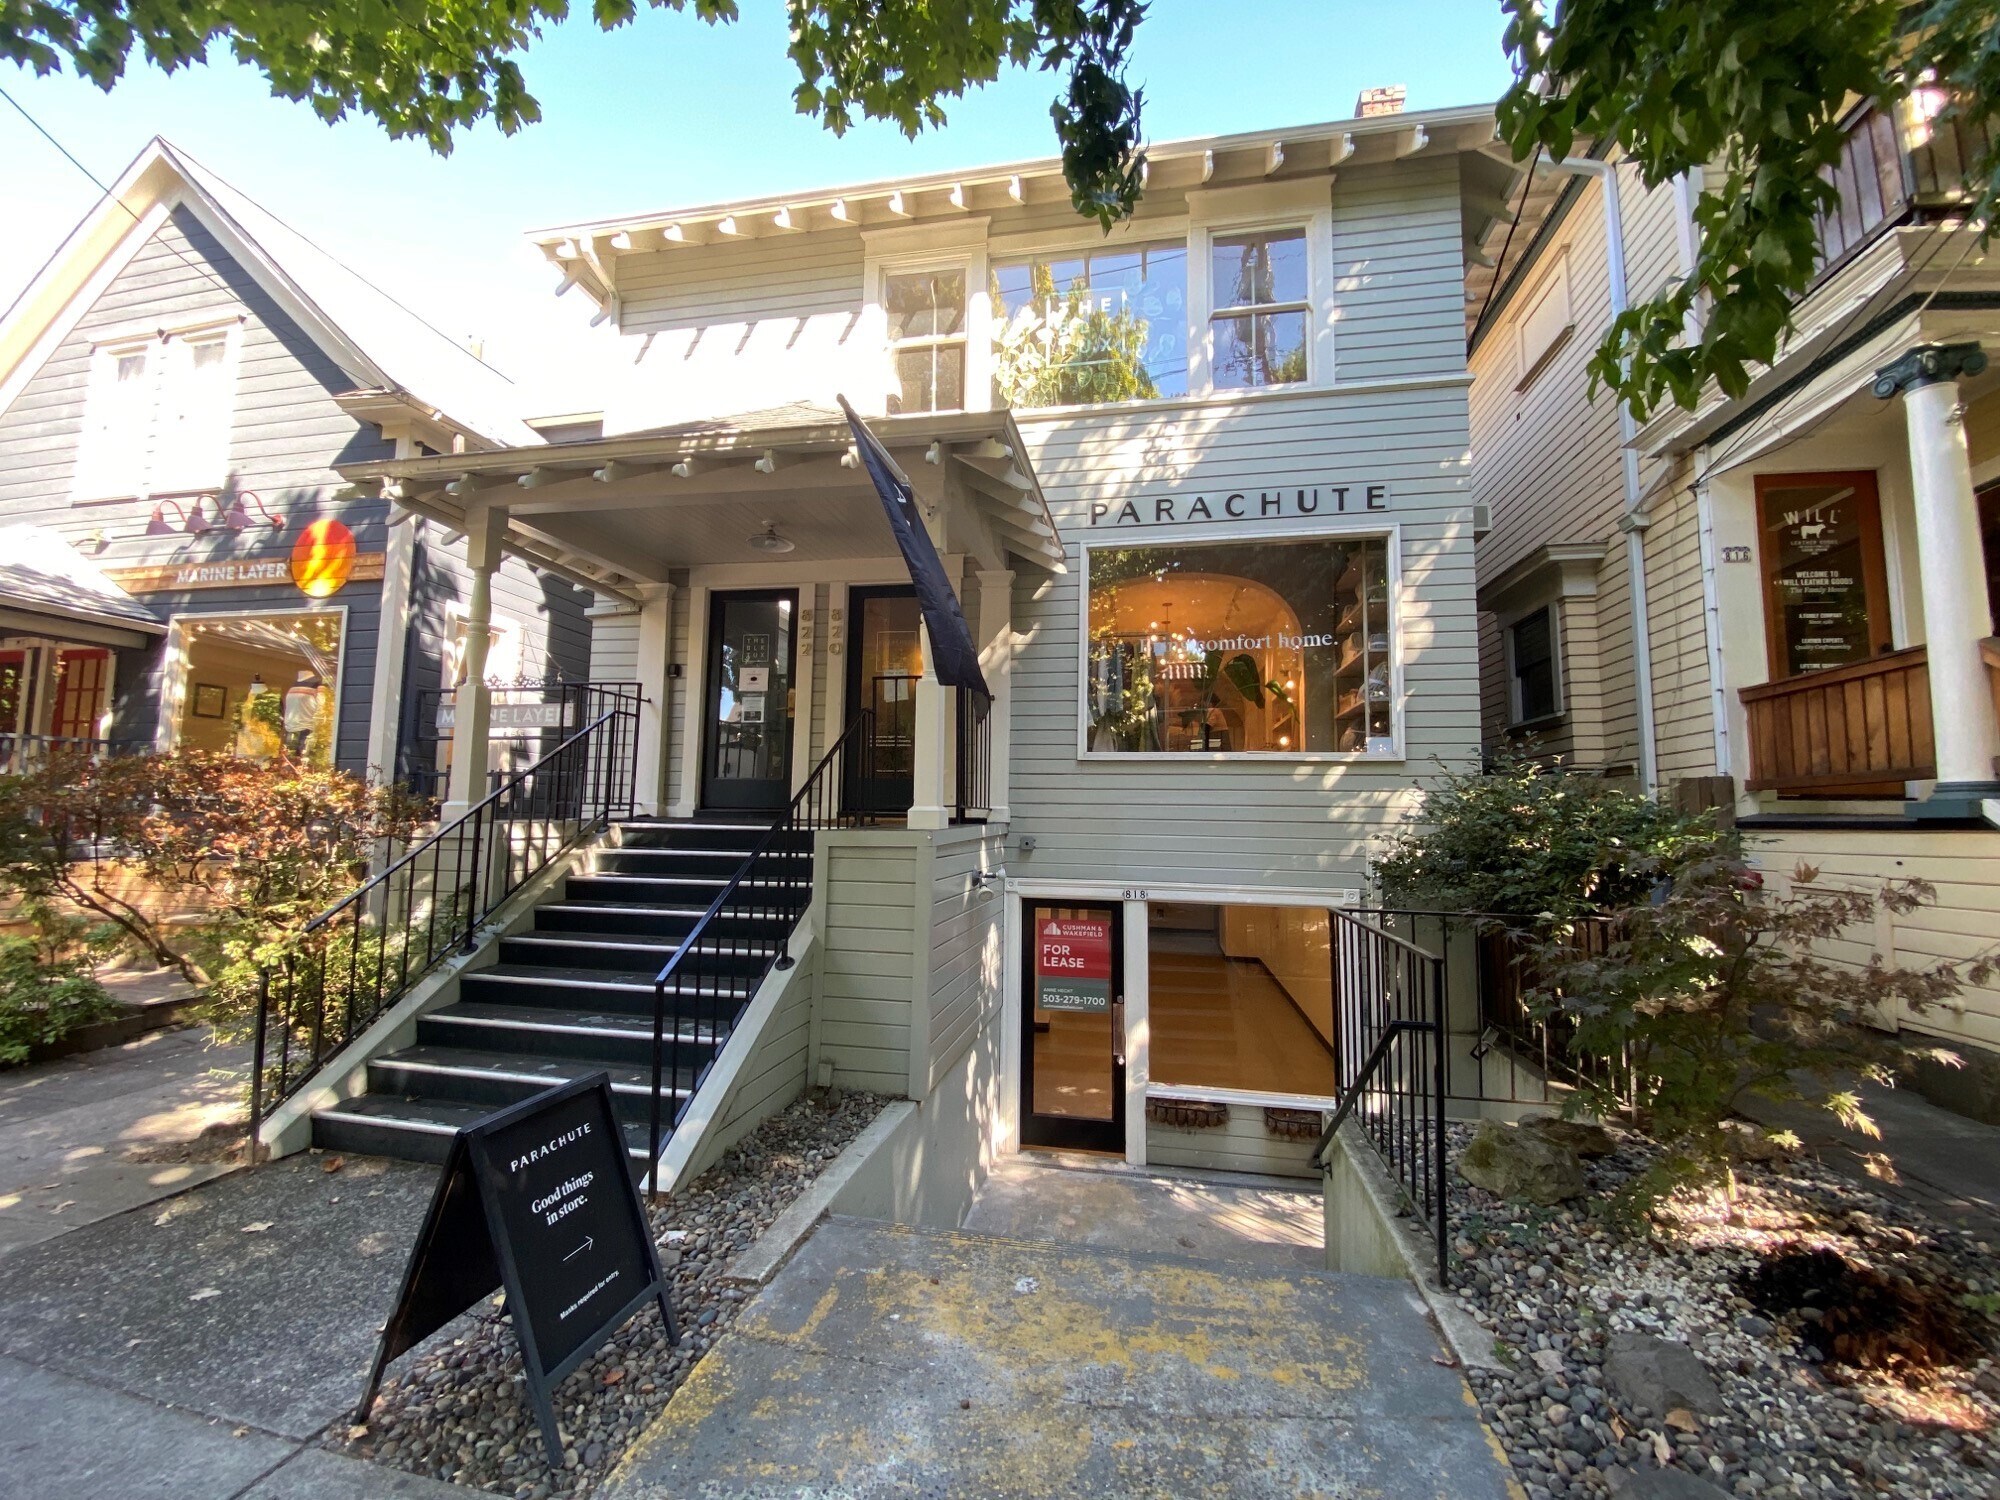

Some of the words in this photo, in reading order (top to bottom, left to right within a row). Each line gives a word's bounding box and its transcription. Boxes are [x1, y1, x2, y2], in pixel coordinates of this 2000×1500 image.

[1058, 297, 1112, 316] THE
[1091, 485, 1386, 526] PARACHUTE
[1783, 508, 1838, 526] WILL
[1725, 551, 1749, 561] 816
[176, 566, 235, 584] MARINE
[238, 562, 288, 580] LAYER
[1796, 570, 1829, 578] WELCOME
[1800, 578, 1830, 586] LEATHER
[1197, 633, 1272, 651] comfort
[1278, 631, 1339, 650] home.
[441, 708, 508, 724] MNE
[1125, 890, 1146, 899] 818
[1062, 924, 1097, 932] CUSHMAN
[1062, 930, 1103, 938] WAKEFIELD
[1043, 944, 1071, 956] FOR
[1043, 956, 1085, 969] LEASE
[1042, 994, 1106, 1006] 503-279-1700
[510, 1122, 592, 1173] PARACHUTE
[531, 1186, 562, 1214] Good
[561, 1171, 594, 1196] things
[546, 1211, 559, 1226] in
[558, 1194, 588, 1218] store.
